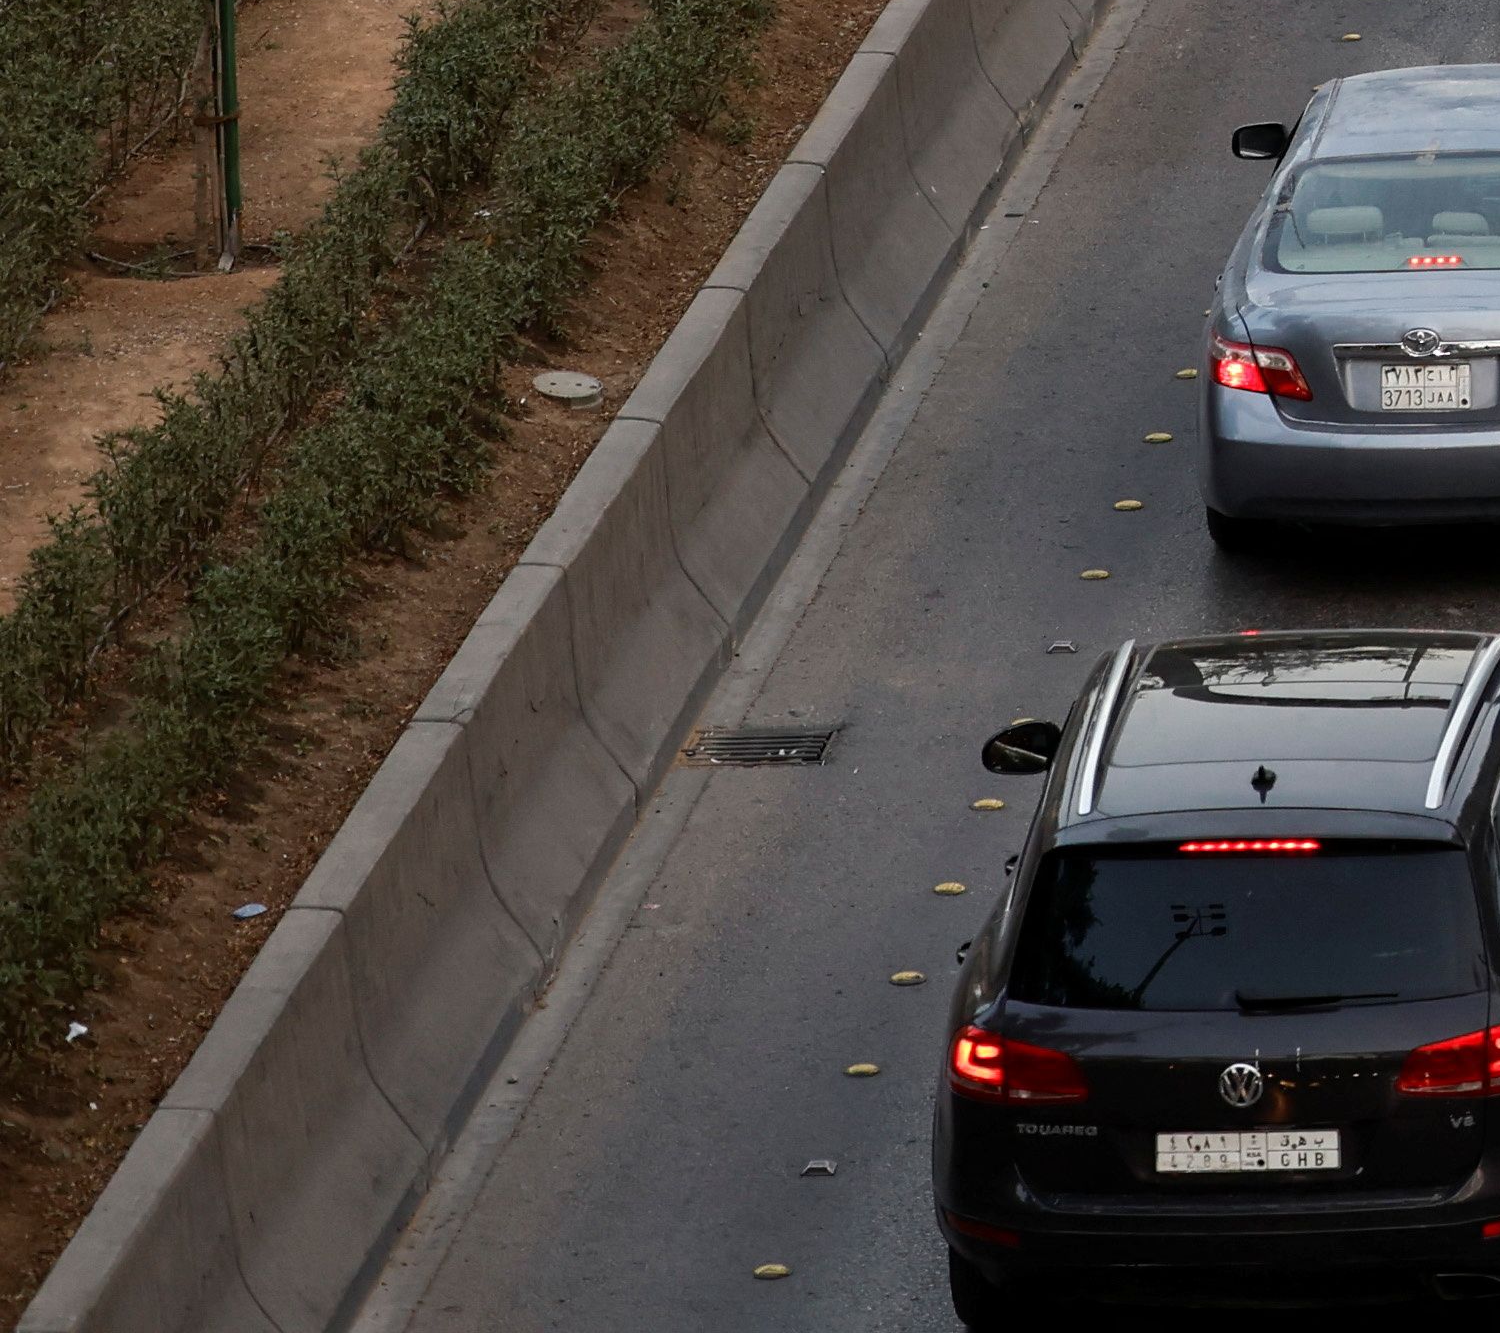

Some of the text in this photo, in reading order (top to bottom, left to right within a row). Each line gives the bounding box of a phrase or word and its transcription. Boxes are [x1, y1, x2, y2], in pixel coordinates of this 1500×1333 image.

[1384, 366, 1423, 386] ٣٧١٣
[1383, 388, 1454, 408] 3713 JAA
[1016, 1123, 1099, 1137] TOUAREG
[1281, 1152, 1324, 1167] GHB
